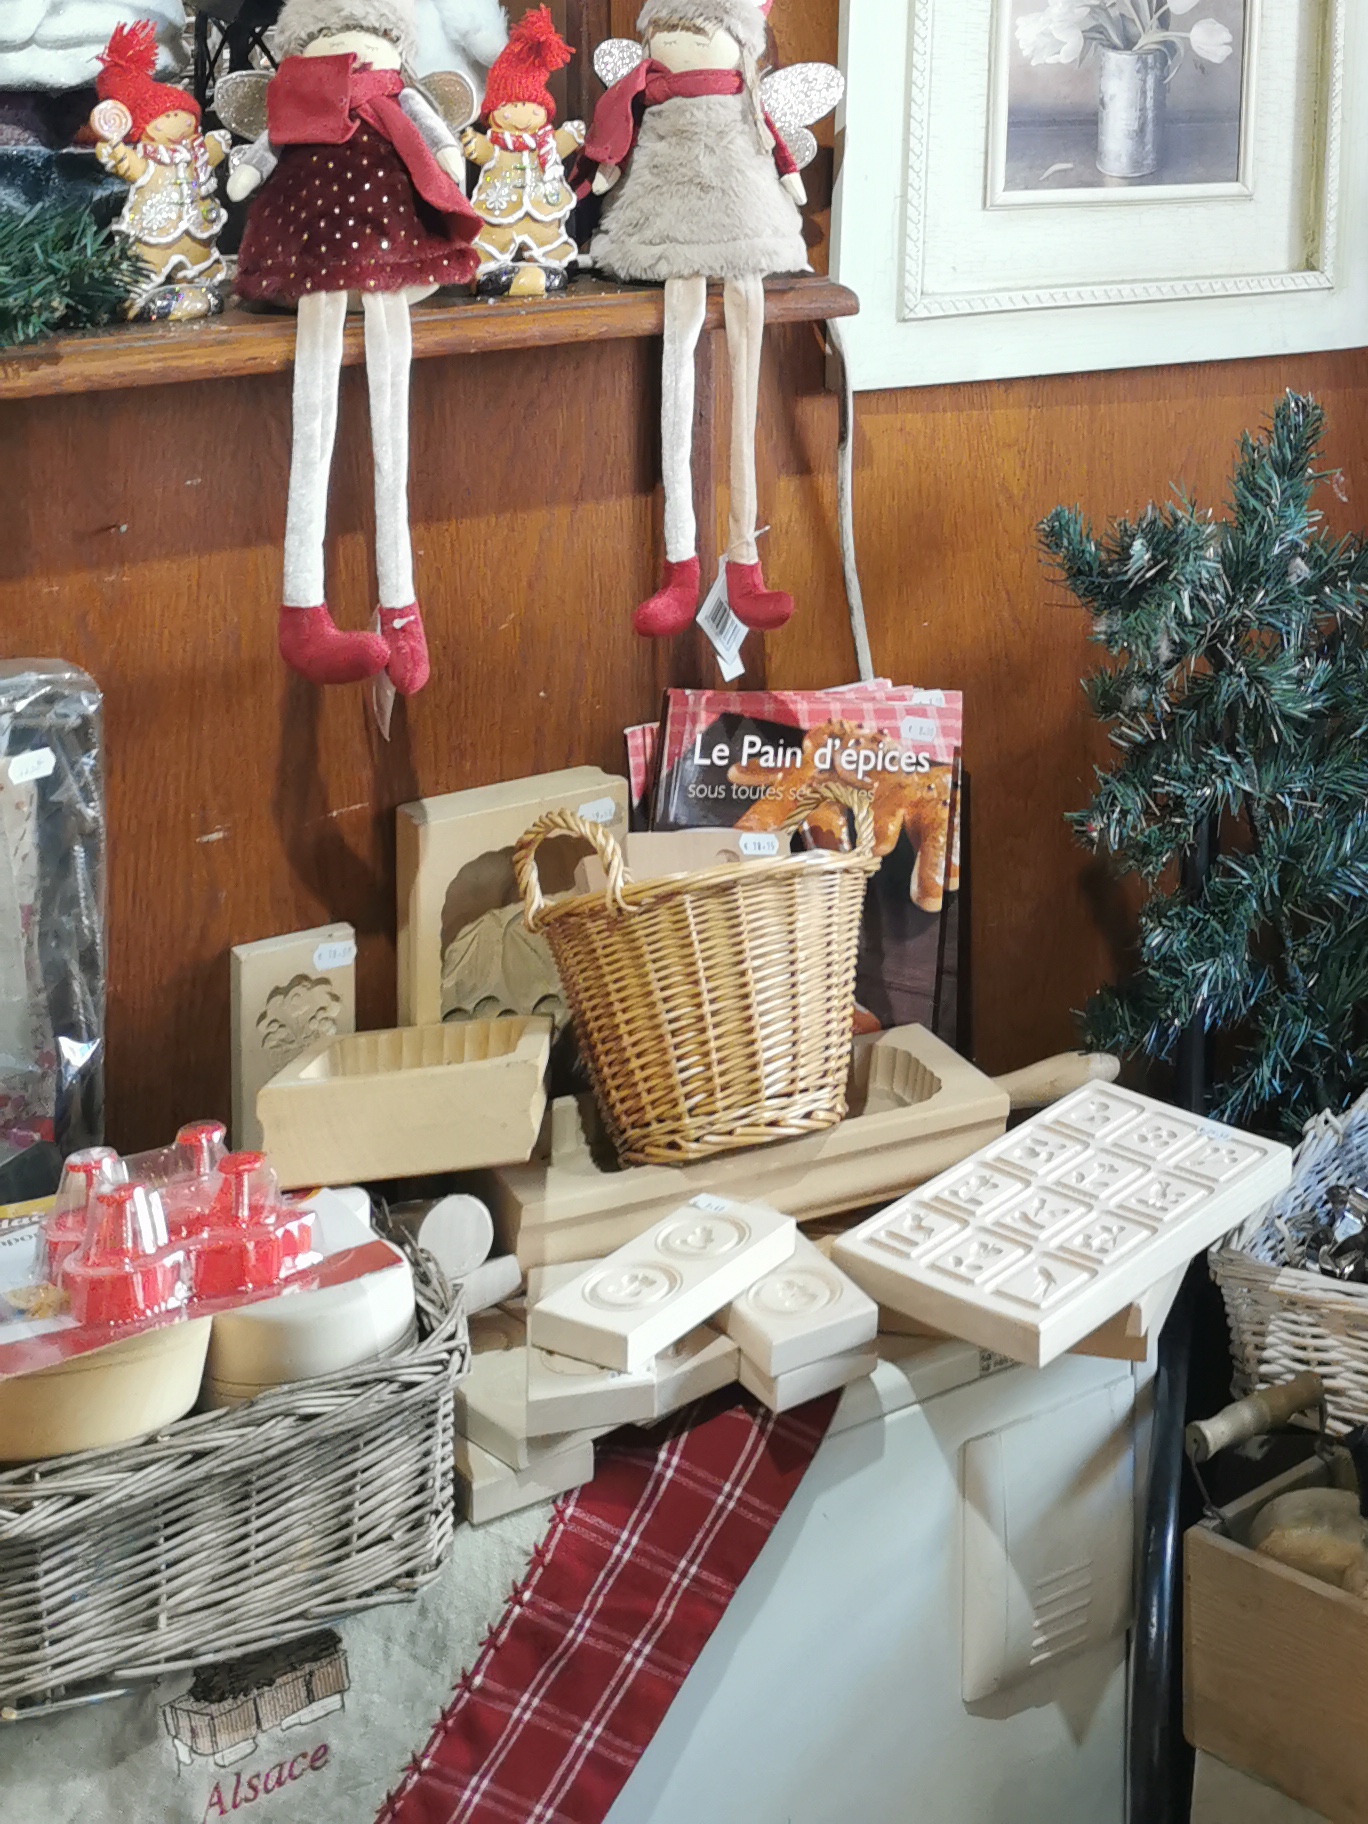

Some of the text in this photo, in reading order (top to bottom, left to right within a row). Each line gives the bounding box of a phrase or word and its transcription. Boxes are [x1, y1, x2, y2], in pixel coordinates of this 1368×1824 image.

[693, 733, 931, 780] Le Pain d'épices
[687, 783, 726, 799] sous
[731, 783, 783, 800] toutes
[203, 1743, 330, 1824] Alsace
